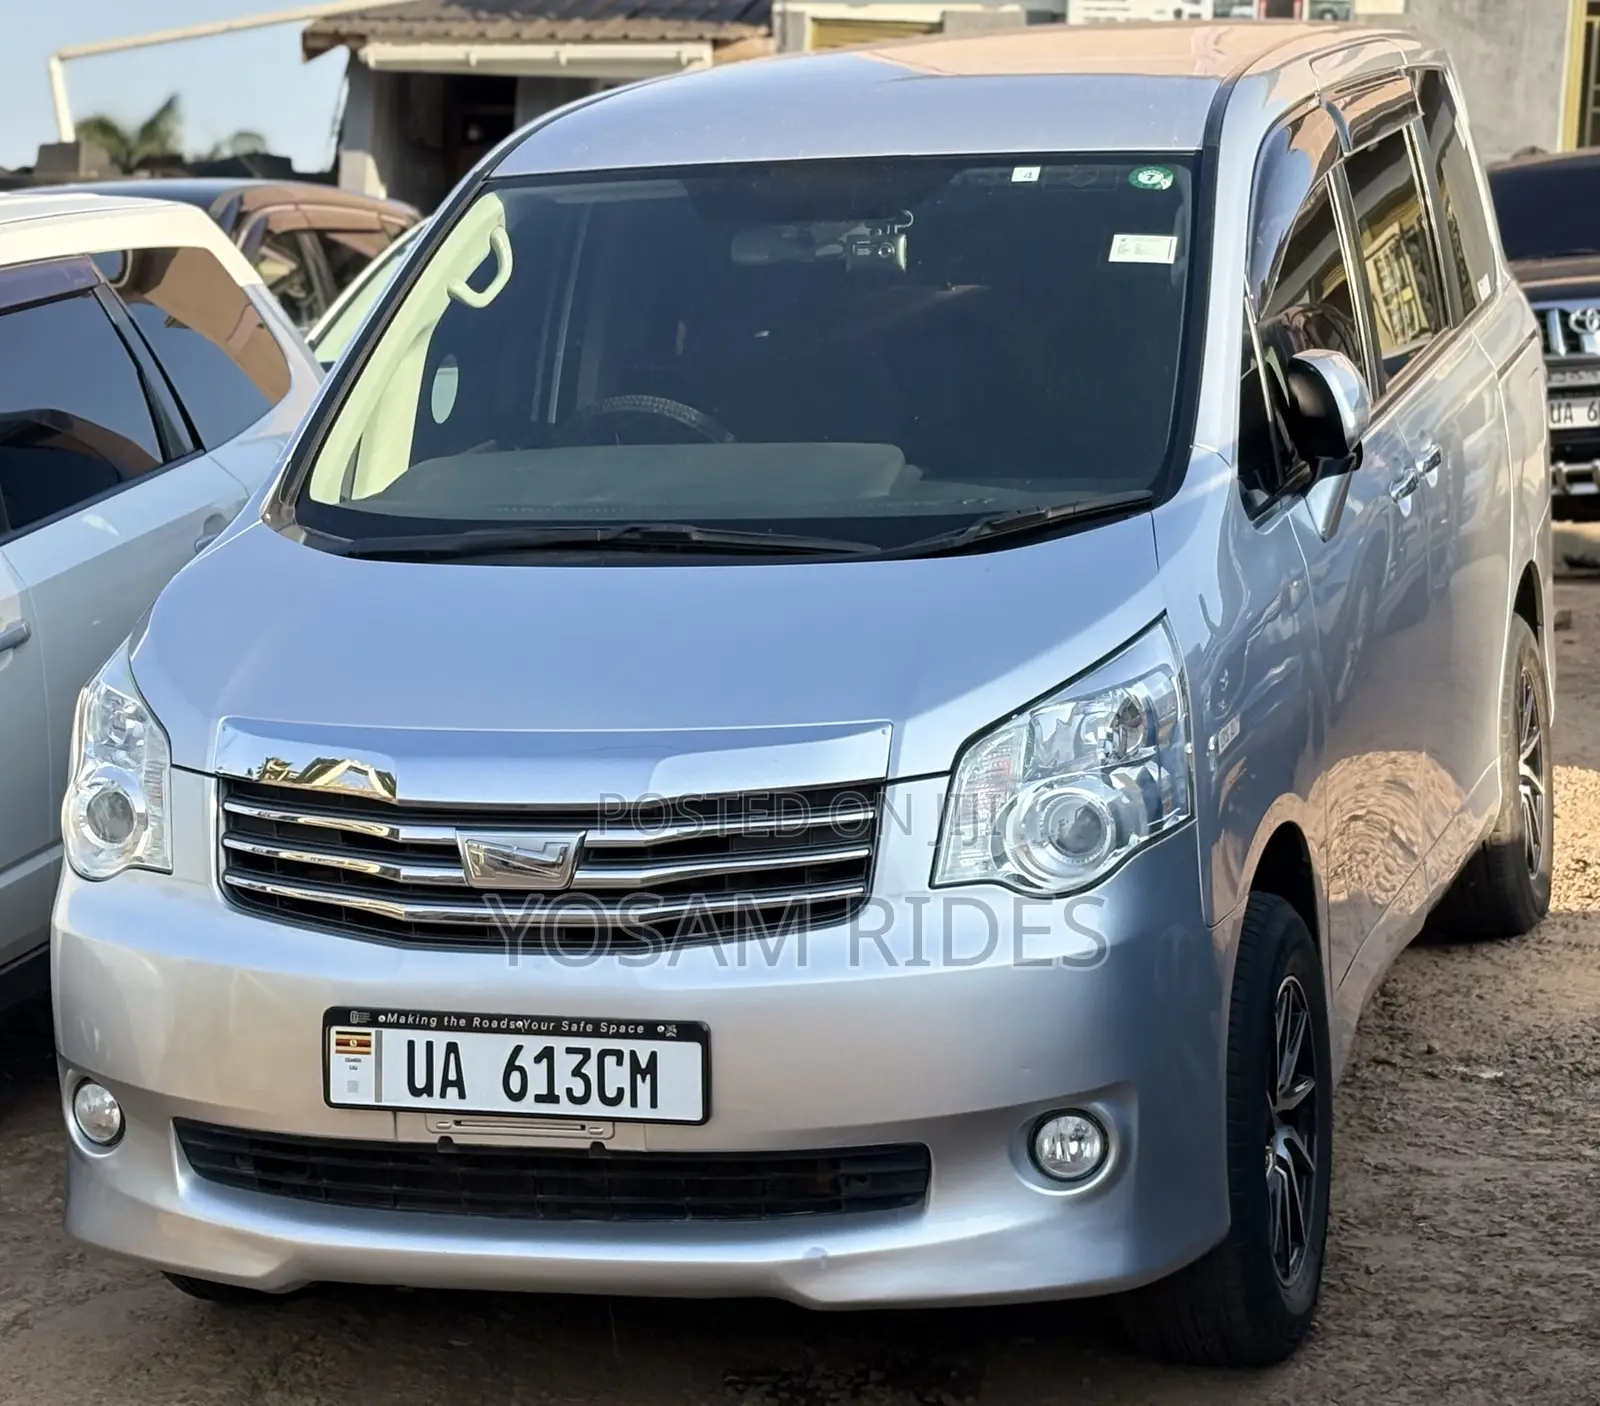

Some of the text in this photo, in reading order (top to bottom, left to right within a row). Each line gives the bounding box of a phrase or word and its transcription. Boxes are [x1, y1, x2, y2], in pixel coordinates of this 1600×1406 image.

[1550, 401, 1600, 424] UA 6
[387, 1012, 645, 1035] Making the Roads Your Safe Space
[406, 1039, 659, 1109] UA 613CM
